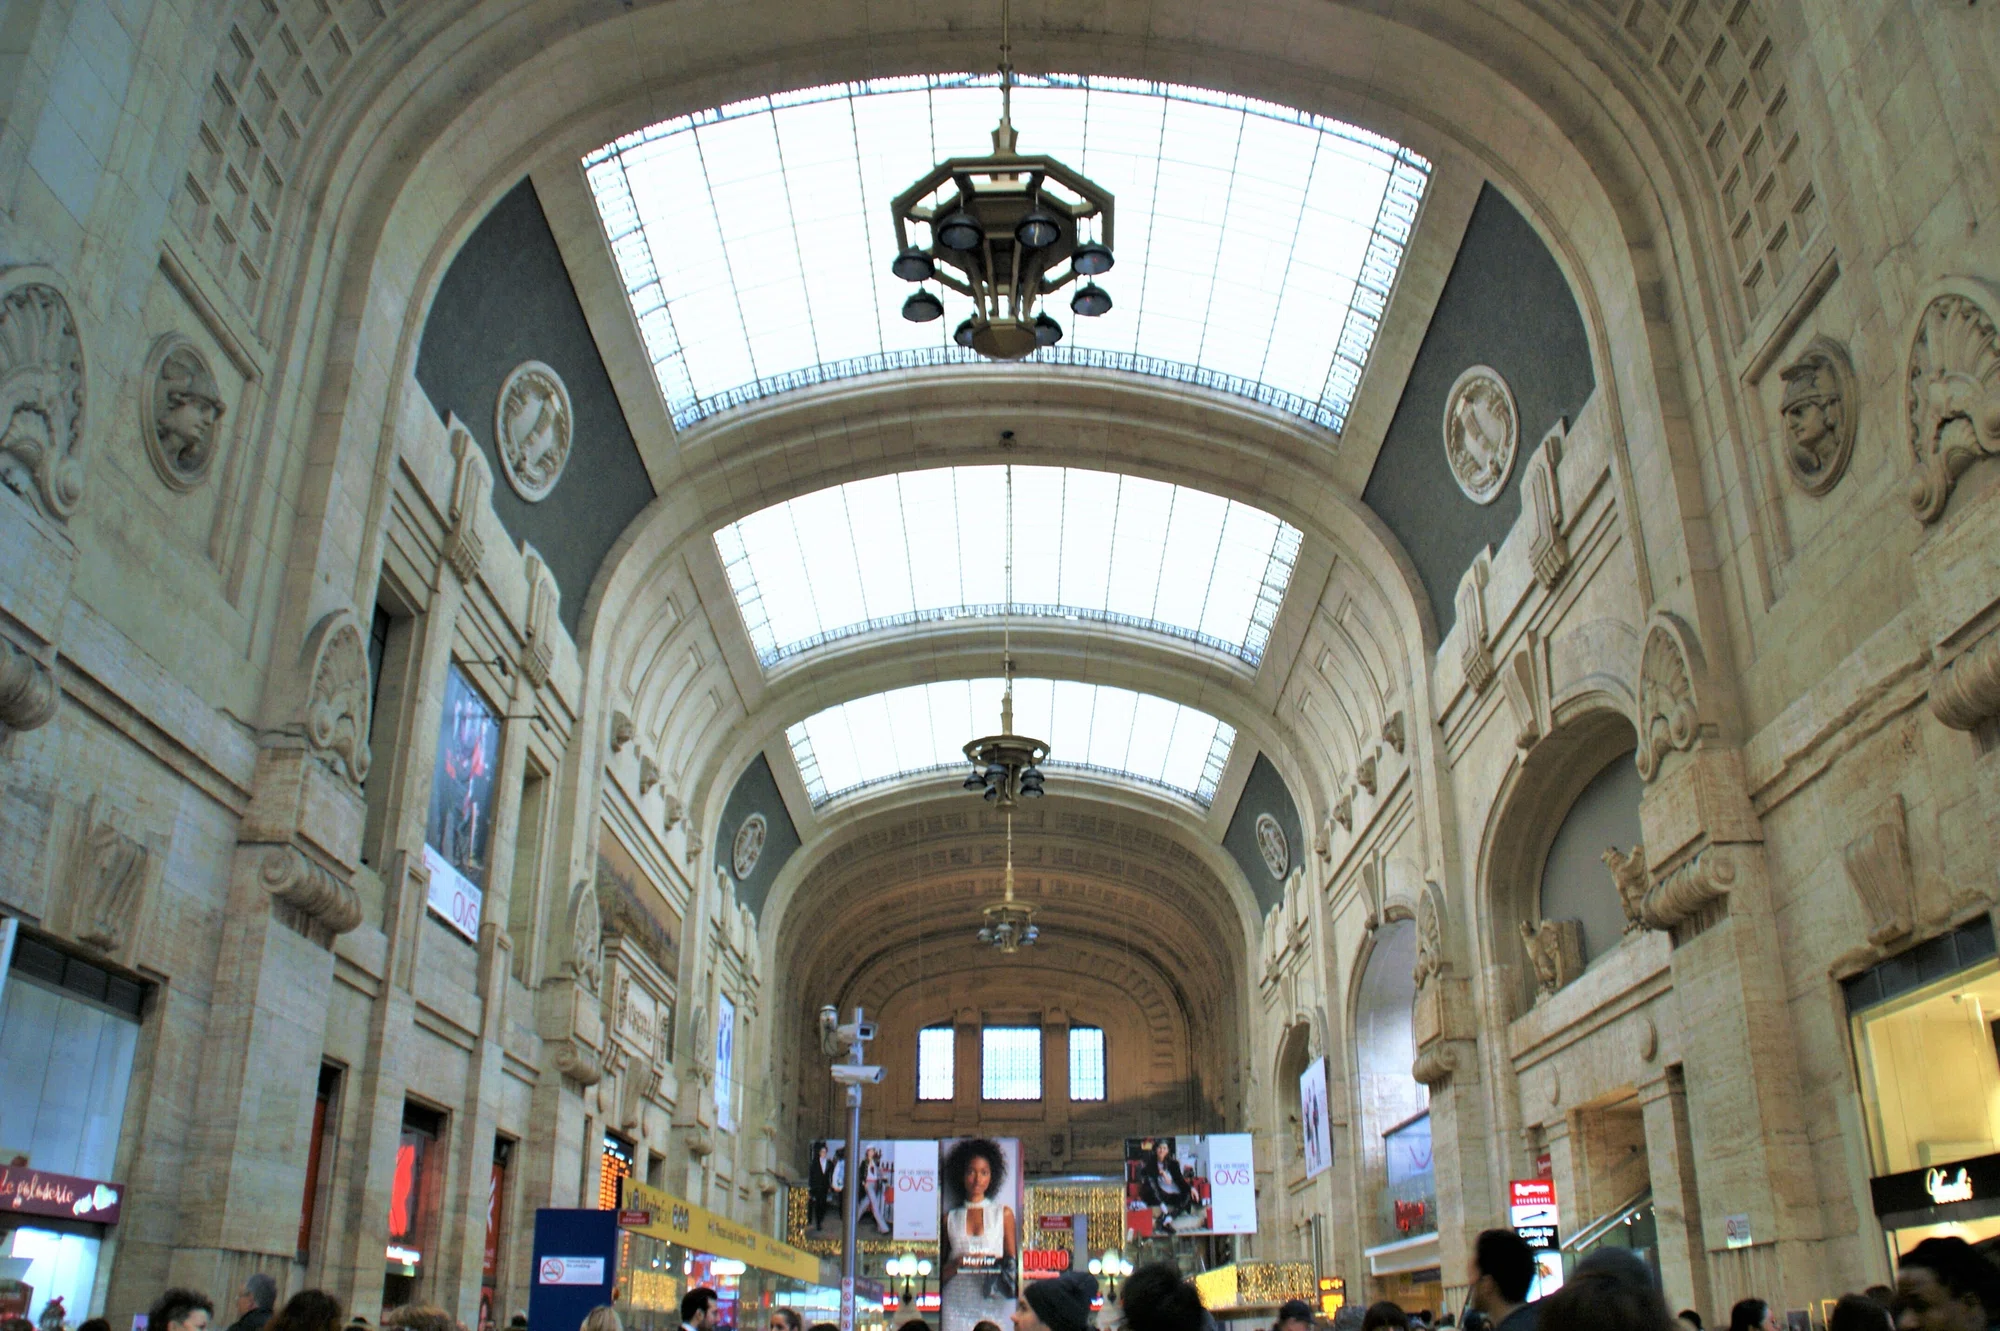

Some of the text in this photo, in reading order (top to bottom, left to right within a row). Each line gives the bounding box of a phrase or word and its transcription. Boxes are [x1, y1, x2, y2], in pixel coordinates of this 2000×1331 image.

[452, 891, 478, 935] OVS
[898, 1175, 935, 1193] OVS
[1214, 1168, 1250, 1186] OVS
[962, 1256, 996, 1266] Merrier
